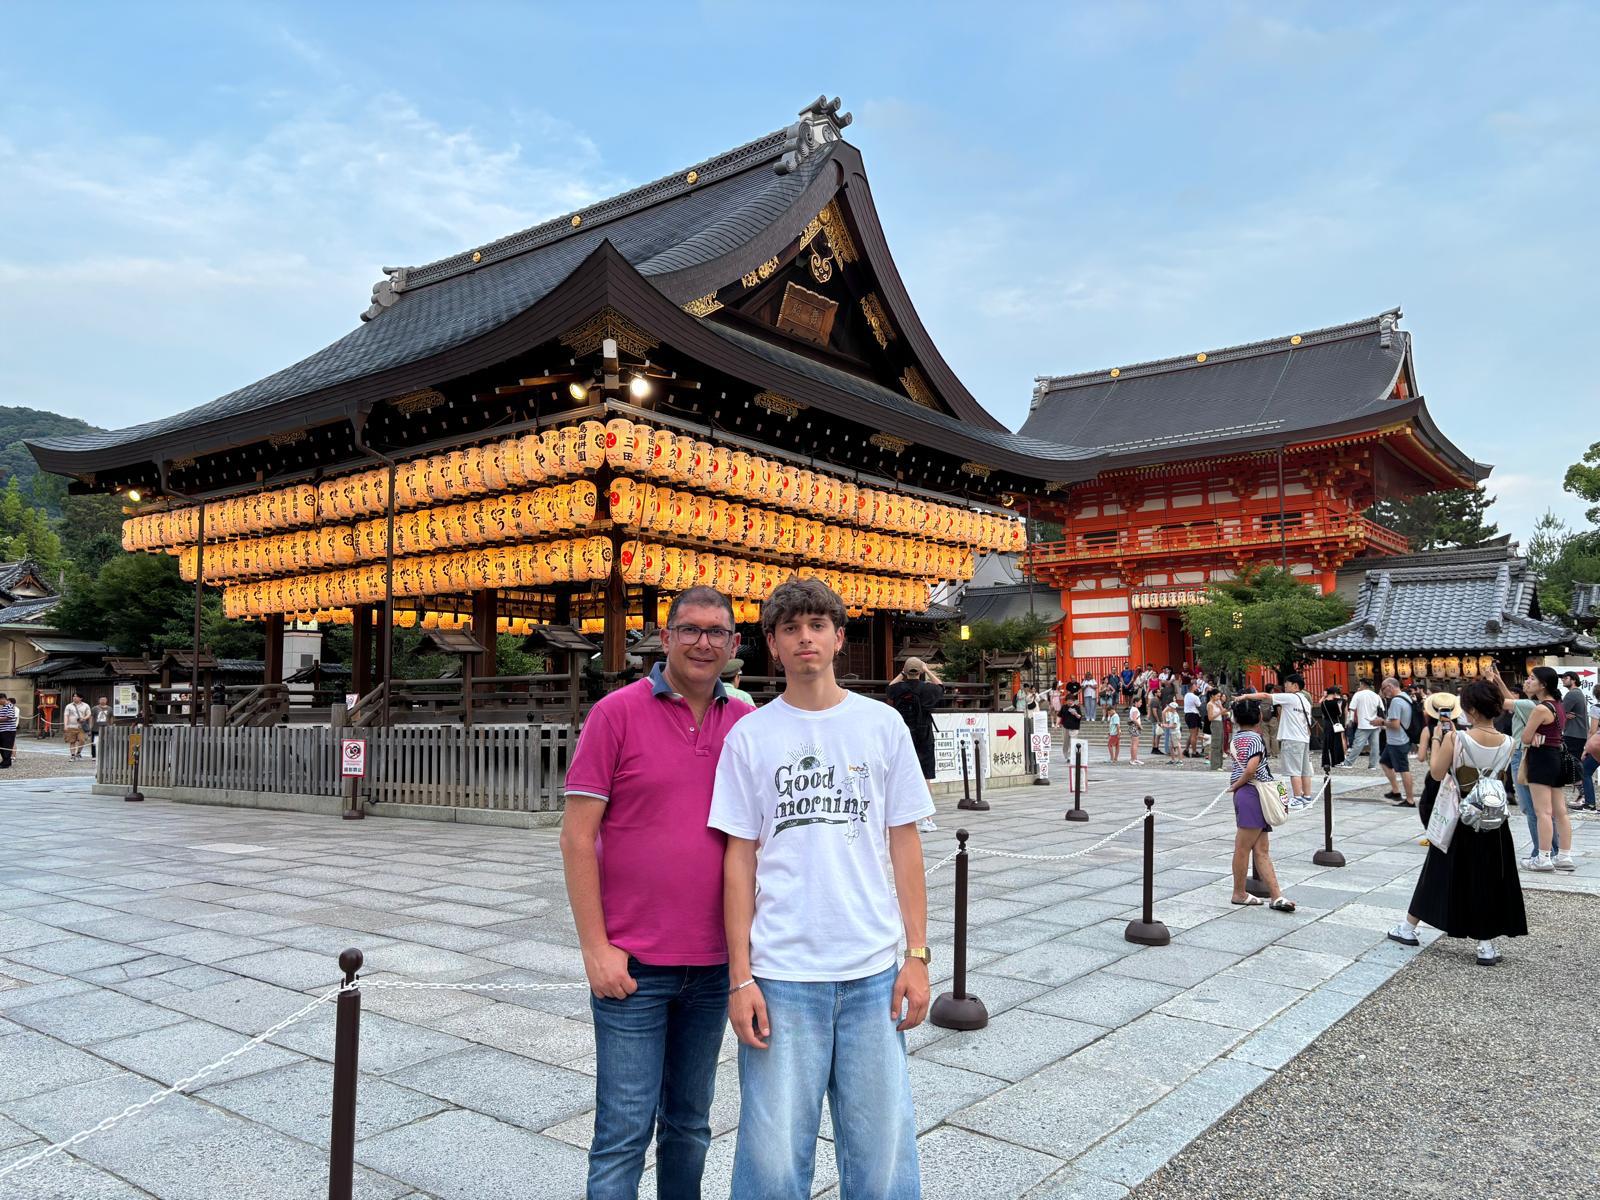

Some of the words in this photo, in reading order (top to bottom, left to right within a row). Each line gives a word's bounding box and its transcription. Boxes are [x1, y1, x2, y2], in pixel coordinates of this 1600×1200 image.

[585, 538, 594, 575] アレックス
[993, 751, 1023, 766] 御朱印受付
[774, 764, 836, 799] Good
[773, 789, 871, 823] morning
